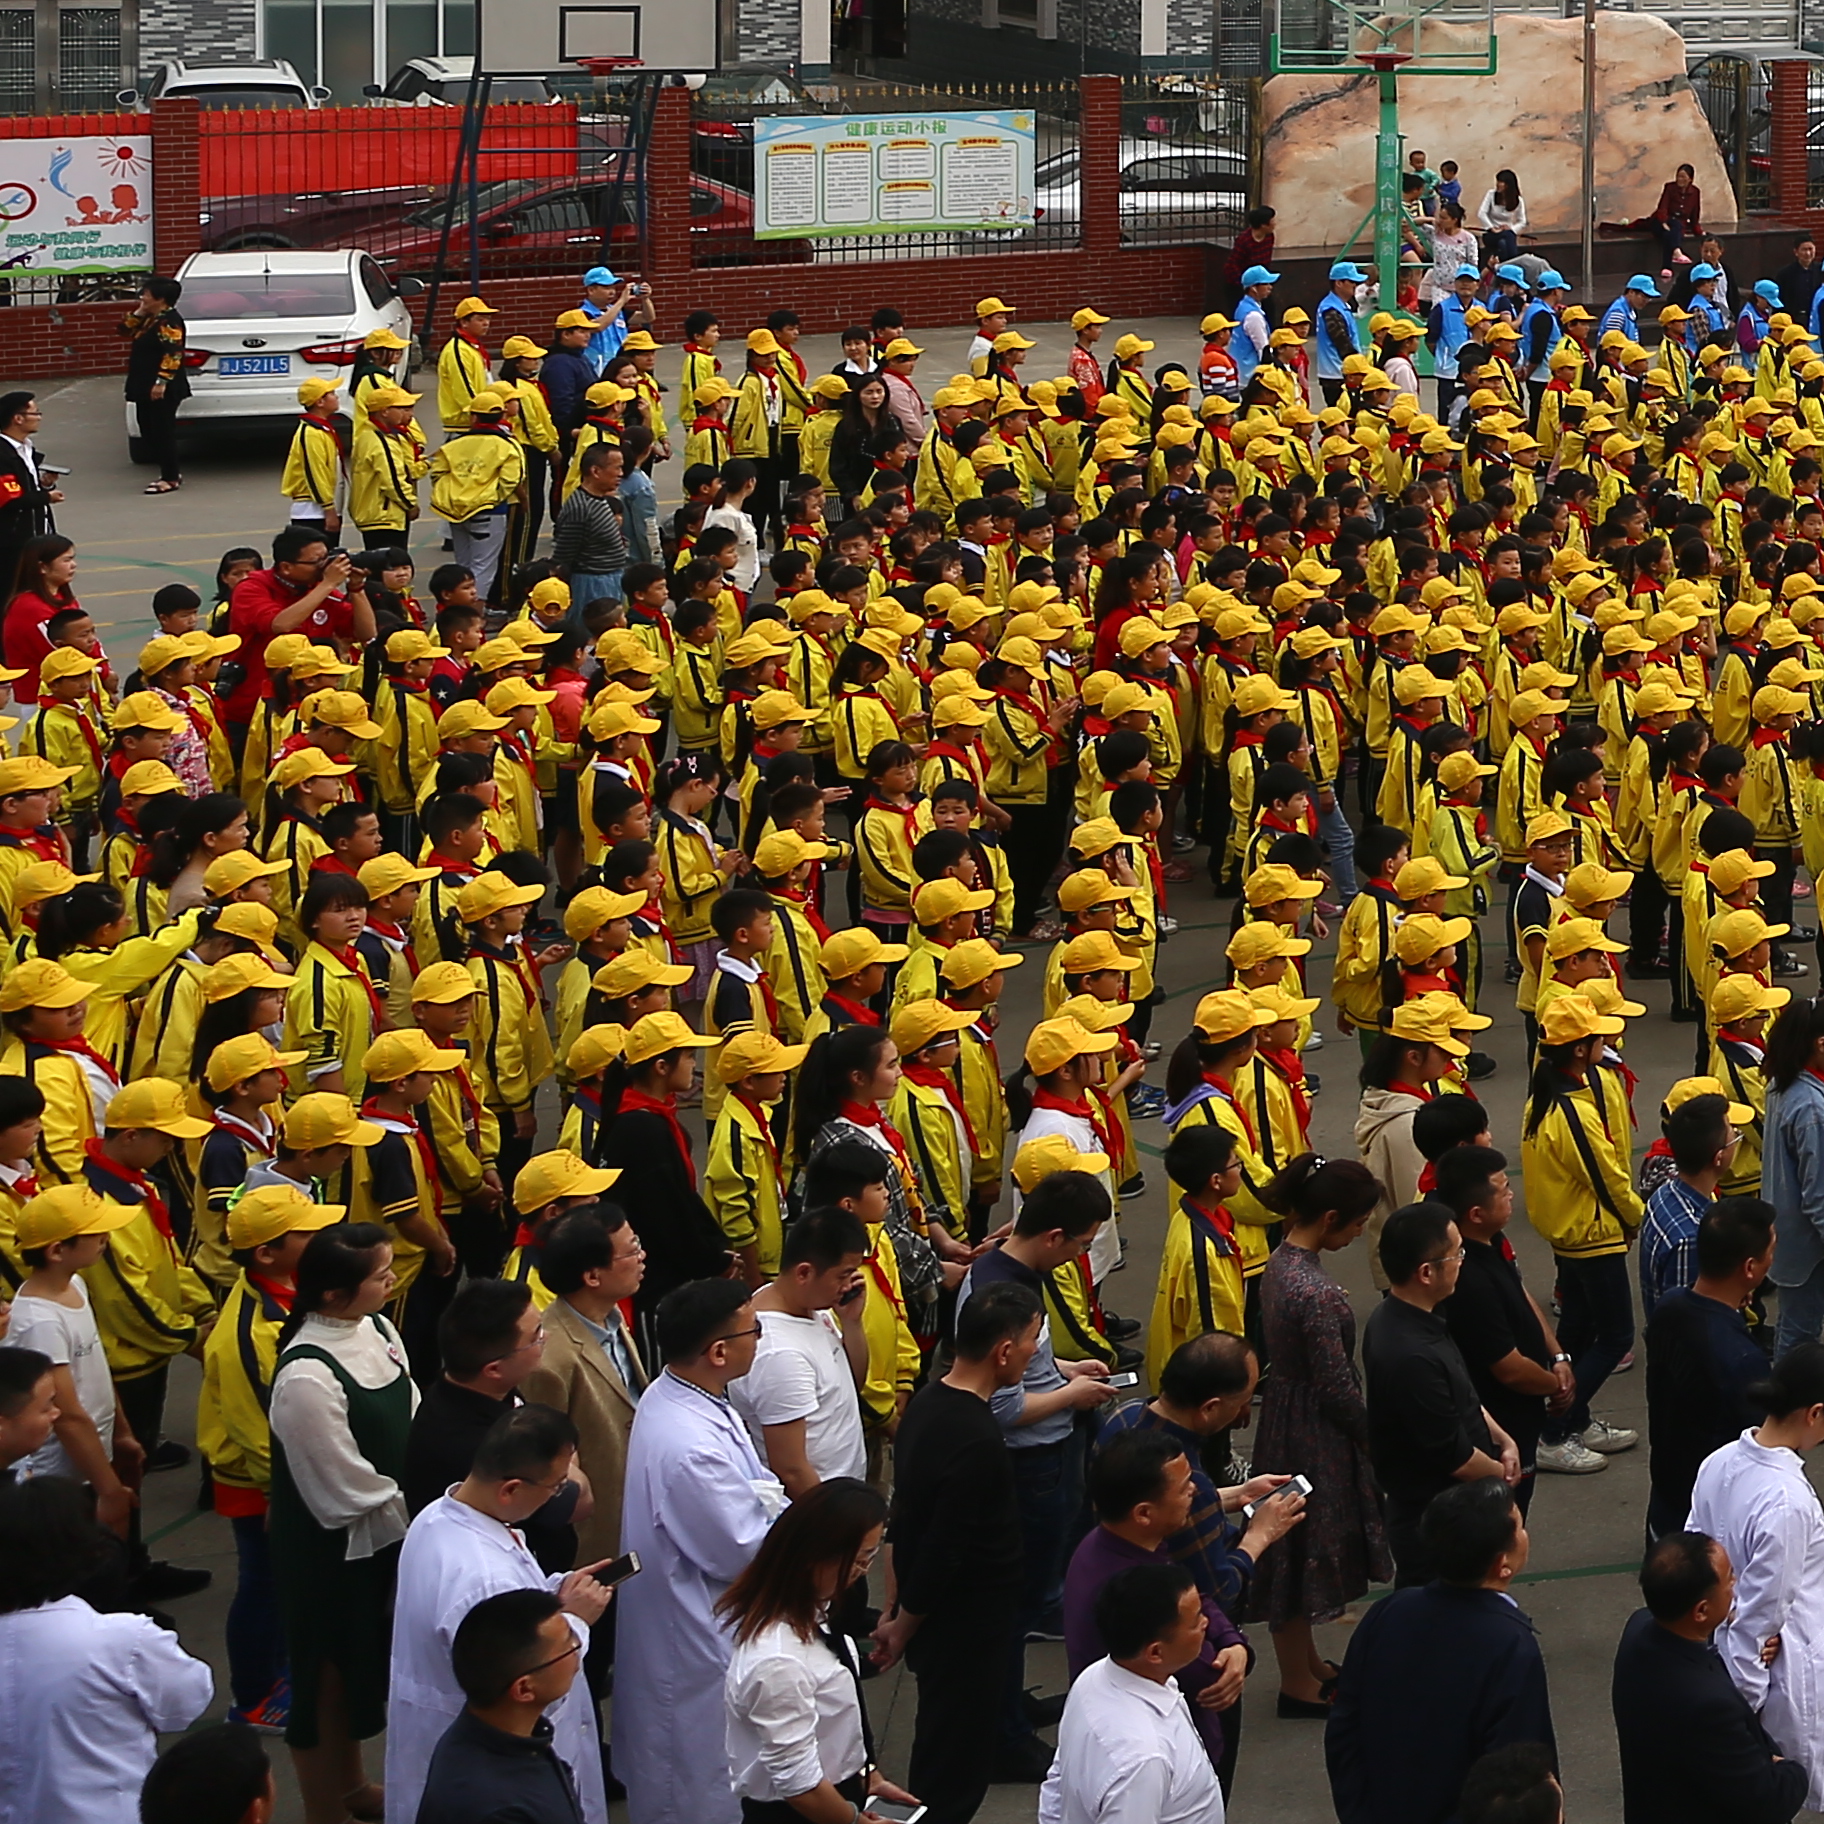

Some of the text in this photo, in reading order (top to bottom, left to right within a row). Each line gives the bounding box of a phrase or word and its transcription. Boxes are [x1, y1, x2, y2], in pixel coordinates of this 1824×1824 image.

[845, 120, 948, 137] 健康运动小报
